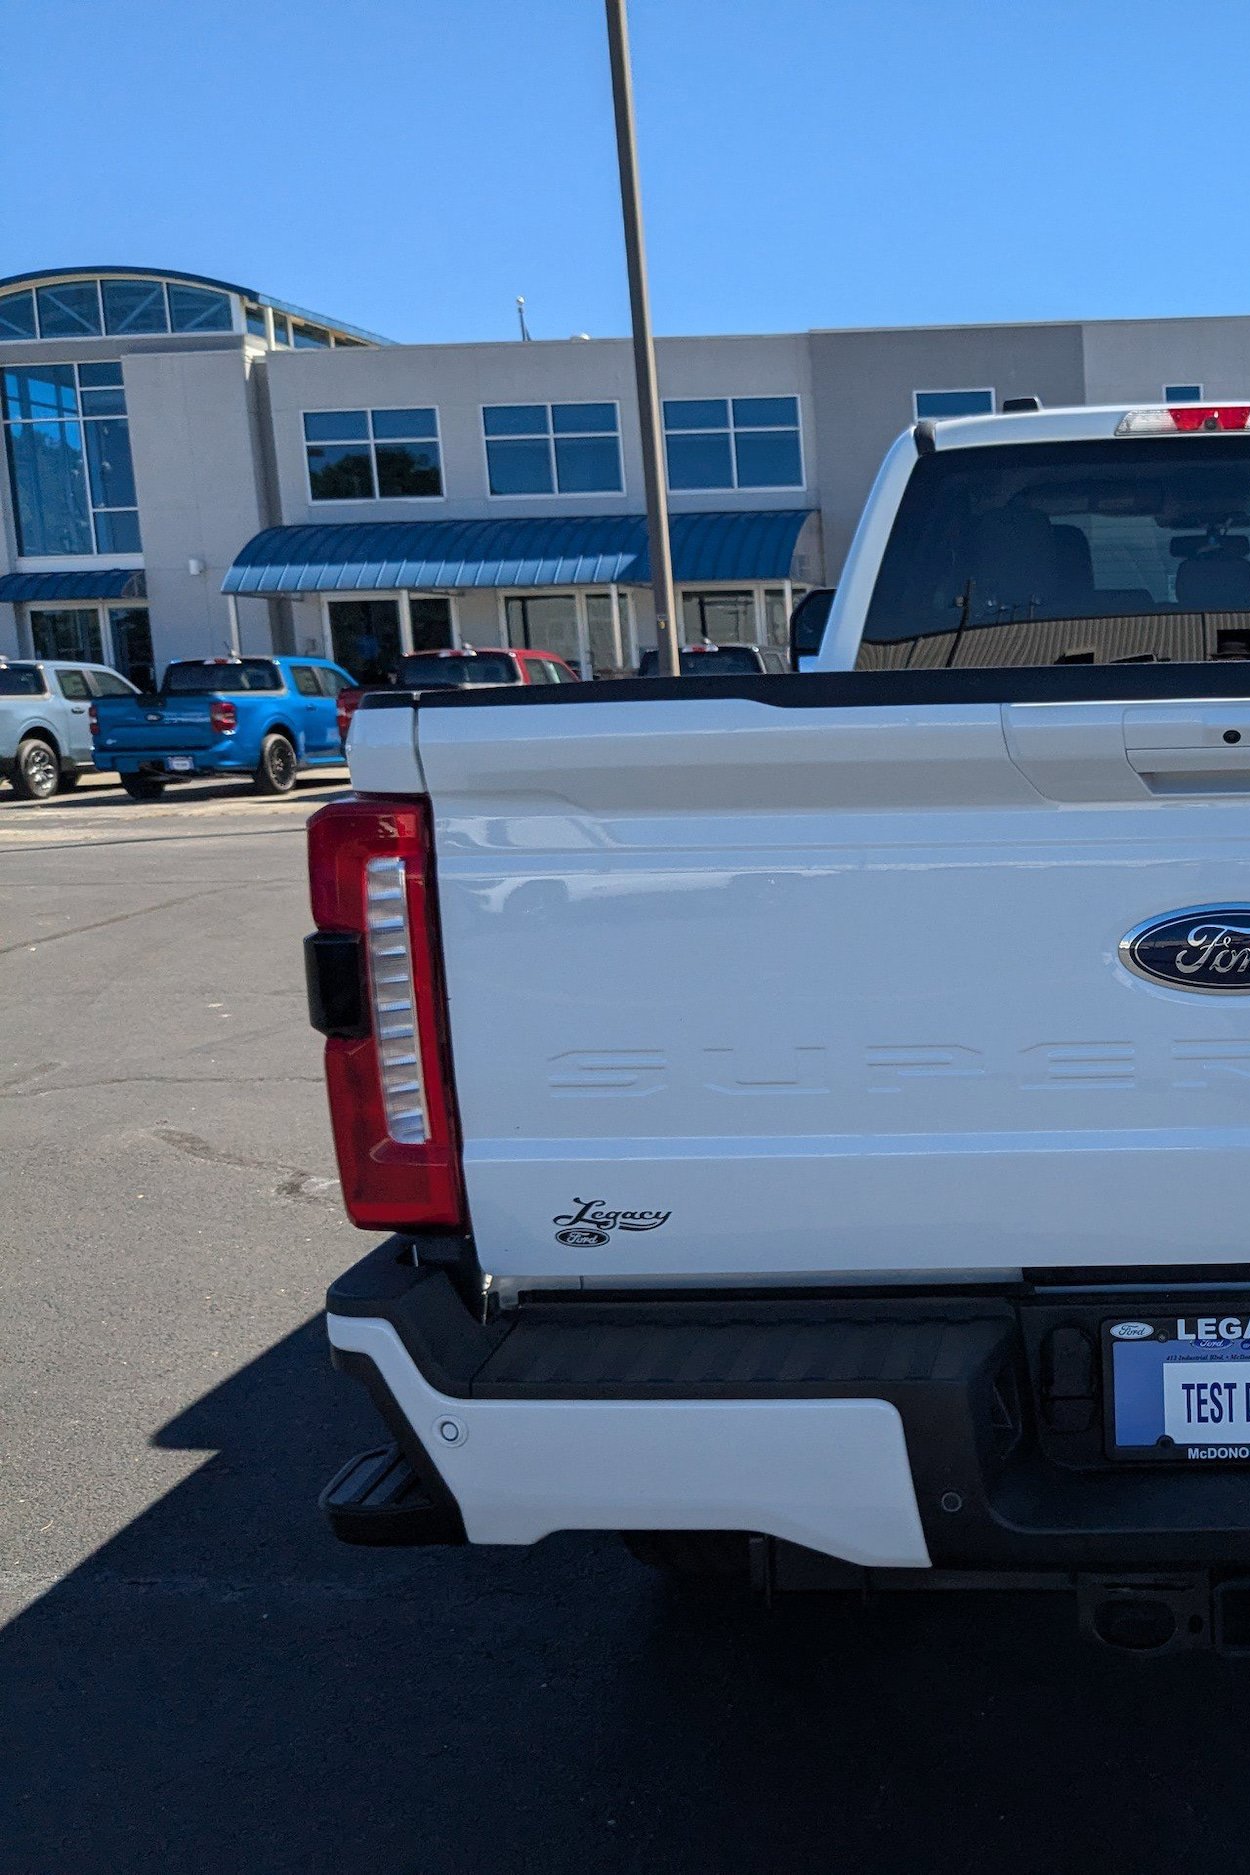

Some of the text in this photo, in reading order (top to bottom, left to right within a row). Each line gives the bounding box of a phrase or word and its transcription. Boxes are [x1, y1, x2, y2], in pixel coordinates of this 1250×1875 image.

[553, 1197, 672, 1231] Legacy
[567, 1231, 599, 1244] Ford
[1118, 1325, 1146, 1337] Ford
[1181, 1382, 1237, 1424] TEST
